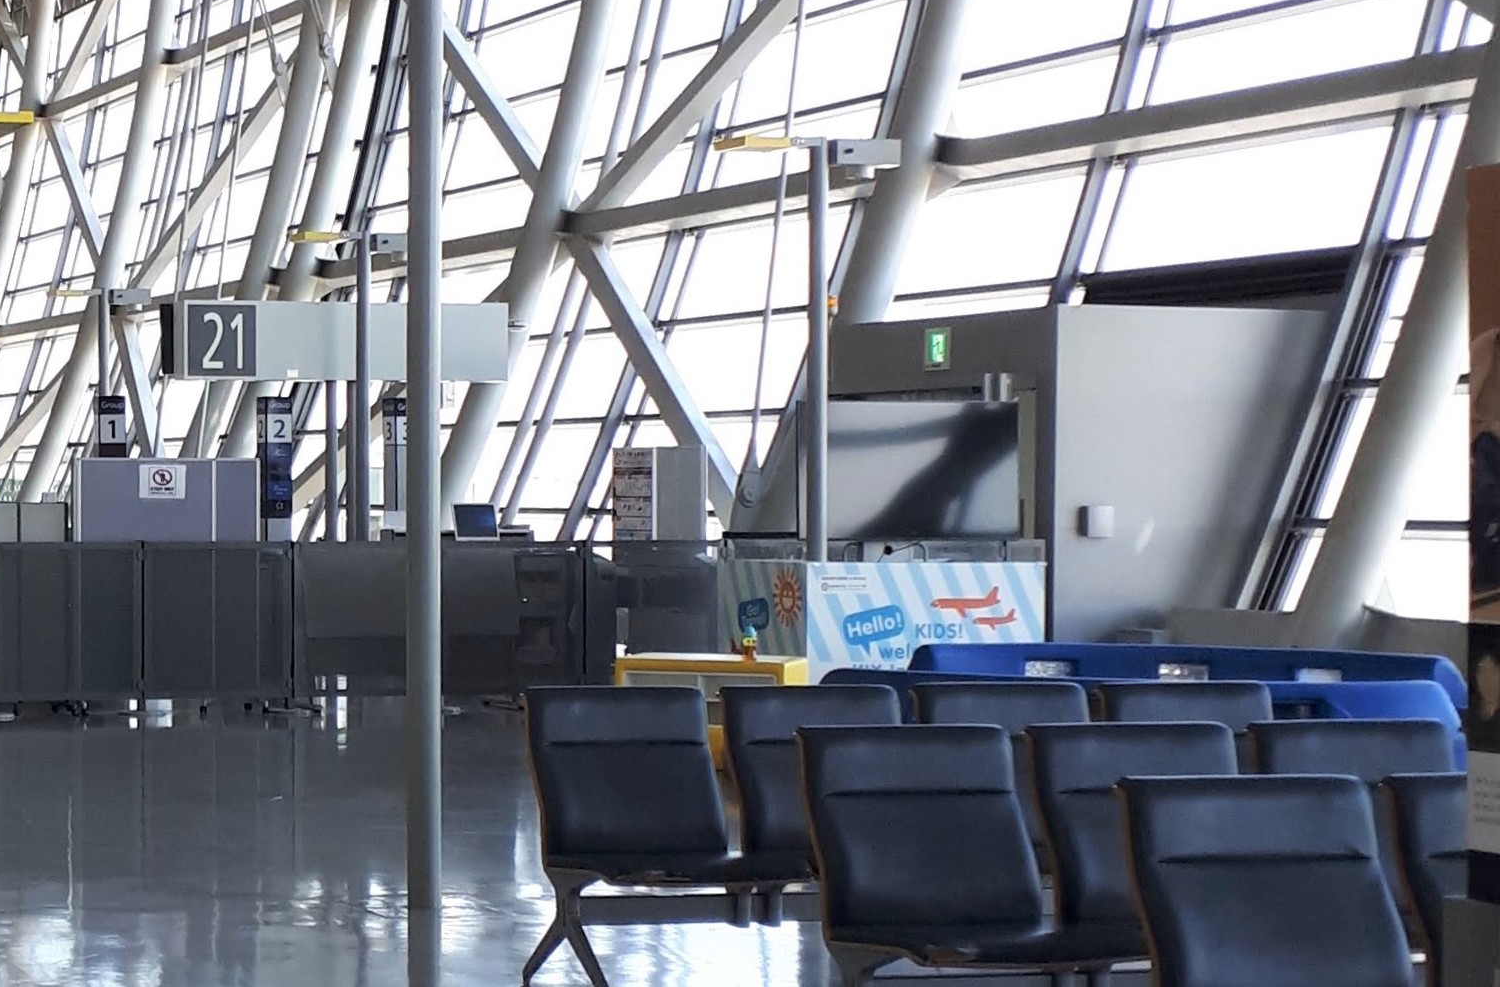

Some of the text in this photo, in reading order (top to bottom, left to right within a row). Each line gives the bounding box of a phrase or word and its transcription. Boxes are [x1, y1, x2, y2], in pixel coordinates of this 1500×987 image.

[202, 312, 244, 369] 21
[101, 400, 125, 410] Group
[107, 419, 116, 439] 1
[273, 419, 286, 439] 2
[386, 421, 393, 440] 3
[846, 612, 903, 639] Hello!
[914, 623, 963, 639] KIDS!
[881, 642, 910, 659] wel
